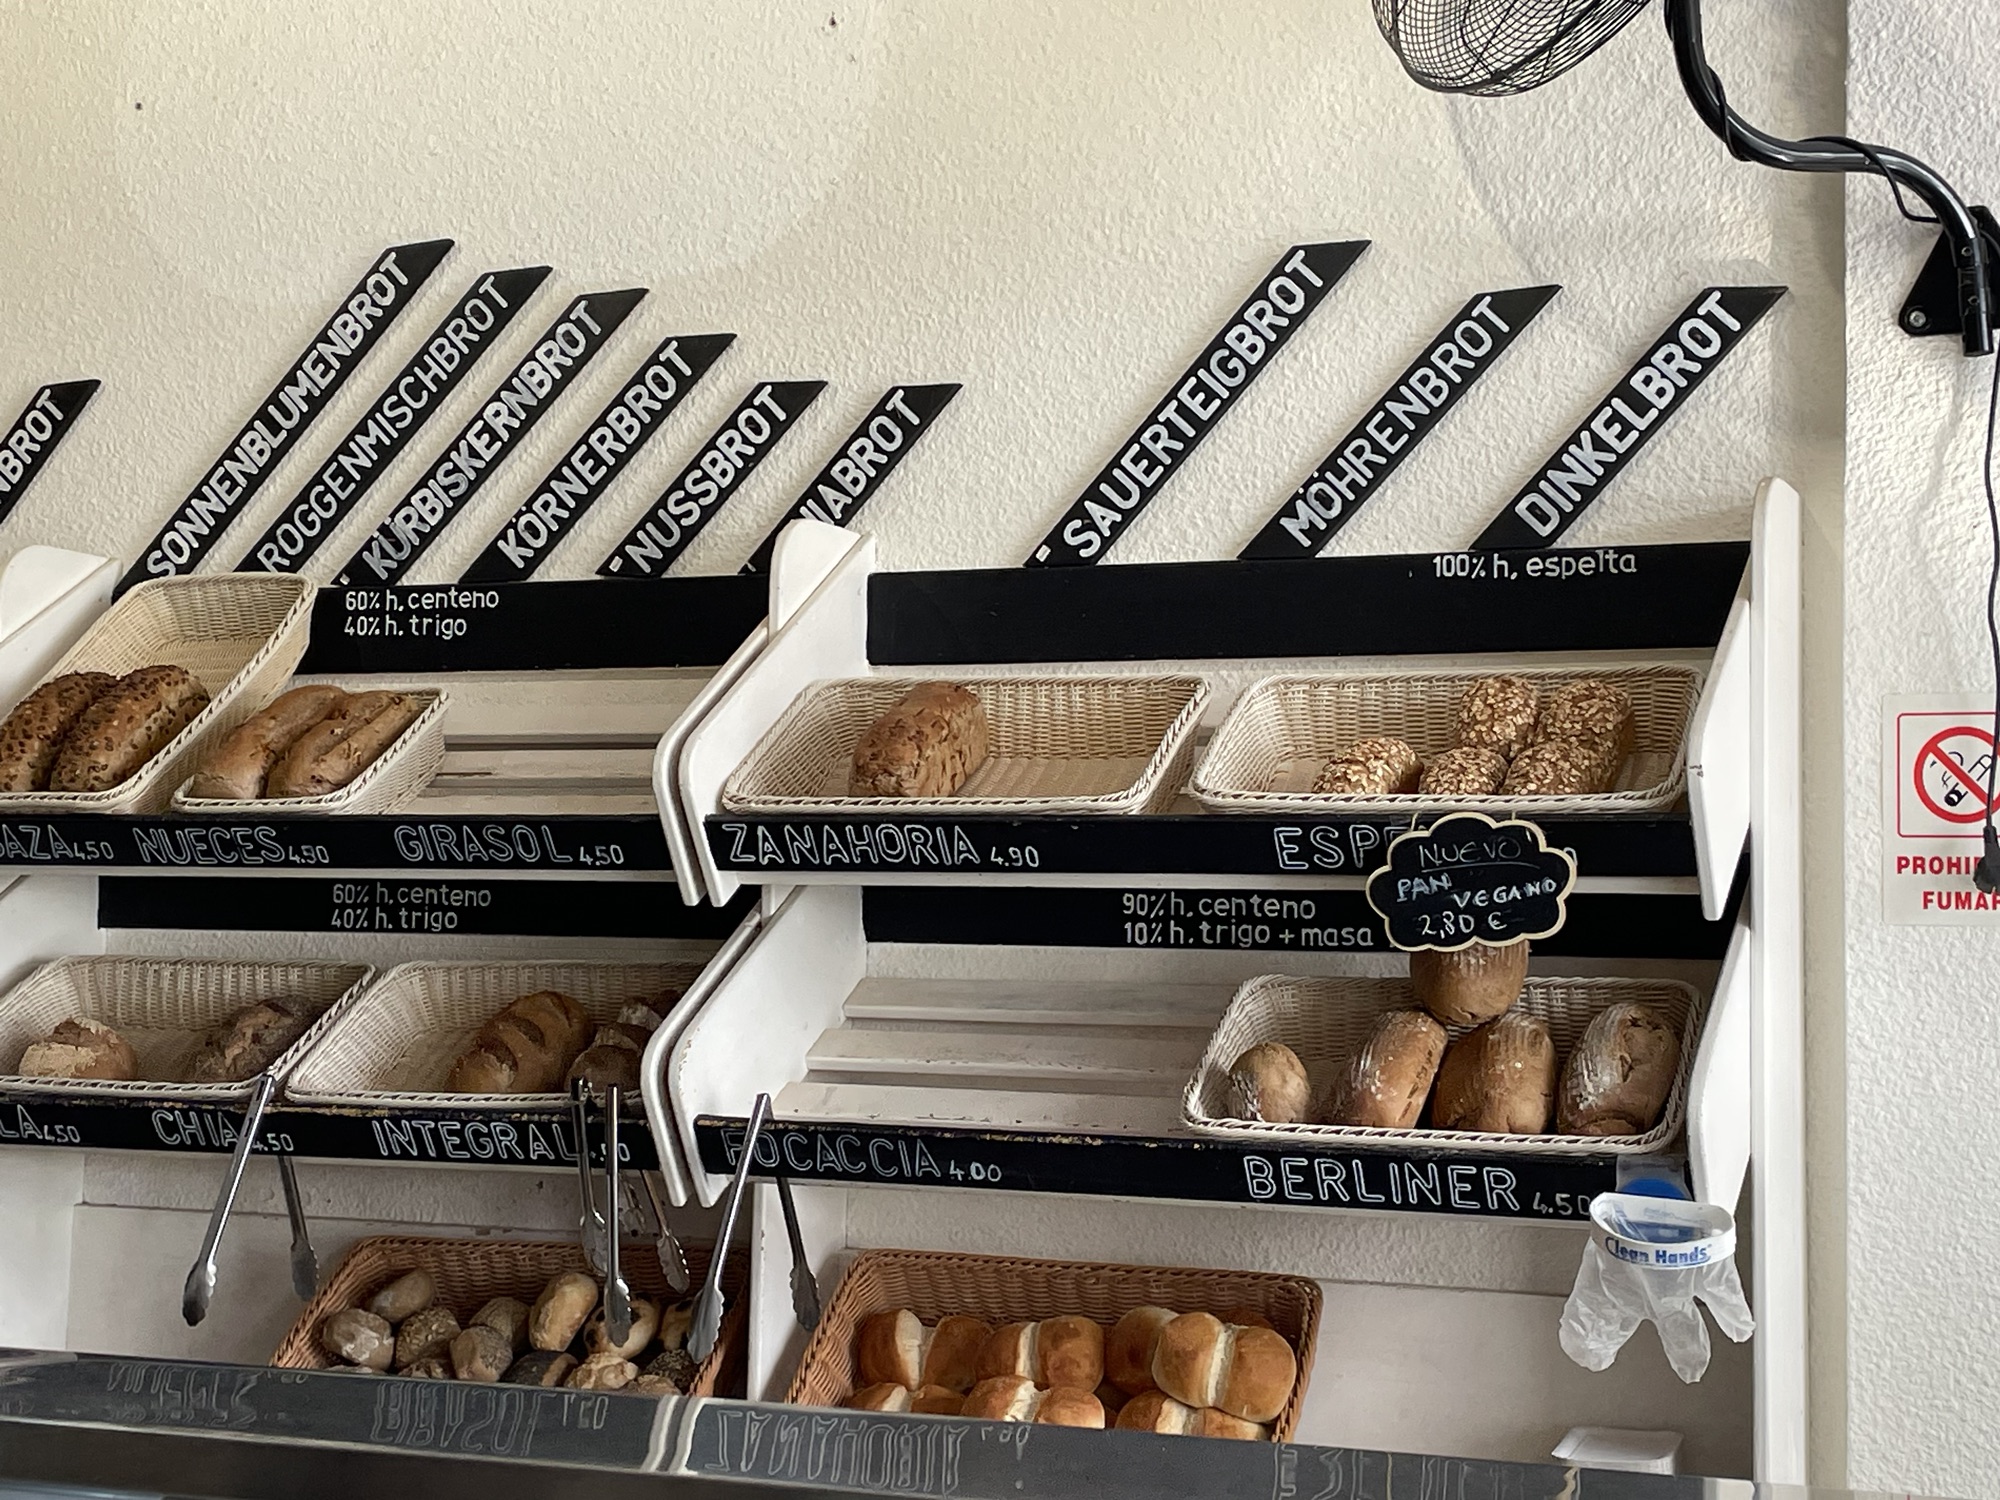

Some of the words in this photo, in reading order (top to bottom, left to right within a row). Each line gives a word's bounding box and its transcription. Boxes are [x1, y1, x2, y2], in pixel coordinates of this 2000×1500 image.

[147, 252, 409, 577] SONNENBLUMENBROT
[1063, 249, 1324, 558] SAUERTEIGBROT
[1279, 295, 1510, 548] MÖHRENBROT
[1515, 290, 1741, 537] DINKELBROT
[257, 275, 511, 573] ROGGENMISCHBROT
[362, 300, 604, 580] KÜRBISKERNBROT
[498, 341, 693, 570] KÖRNERBROT
[625, 385, 788, 575] NUSSBROT
[1433, 554, 1486, 579] 100%
[1526, 549, 1637, 579] espelta
[345, 591, 380, 611] 60%
[408, 586, 499, 609] centeno
[344, 616, 380, 636] 40%
[409, 614, 467, 640] trigo
[0, 824, 73, 859] AZA
[133, 826, 285, 863] NUECES
[394, 824, 573, 863] GIRASOL
[722, 824, 981, 865] ZANAHORIA
[990, 846, 1039, 867] 4.90
[1419, 836, 1521, 867] NUEVO
[333, 884, 369, 904] 60%
[397, 884, 491, 907] centeno
[1122, 893, 1167, 918] 90%
[1198, 894, 1316, 919] centeno
[1396, 873, 1451, 902] PAN
[1453, 878, 1557, 909] VEGANO
[331, 907, 368, 928] 40%
[399, 906, 458, 932] trigo
[1124, 921, 1162, 945] 10%
[1198, 918, 1271, 948] trigo
[1301, 926, 1374, 947] masa
[1418, 910, 1474, 939] 2,80
[1488, 911, 1507, 930] €
[152, 1109, 239, 1147] CHIA
[372, 1119, 580, 1161] INTEGRAL
[720, 1128, 941, 1178] FOCACCIA
[949, 1159, 1002, 1182] 4.00
[1243, 1155, 1519, 1211] BERLINER
[1605, 1237, 1650, 1264] Clean
[1655, 1246, 1711, 1264] Hands
